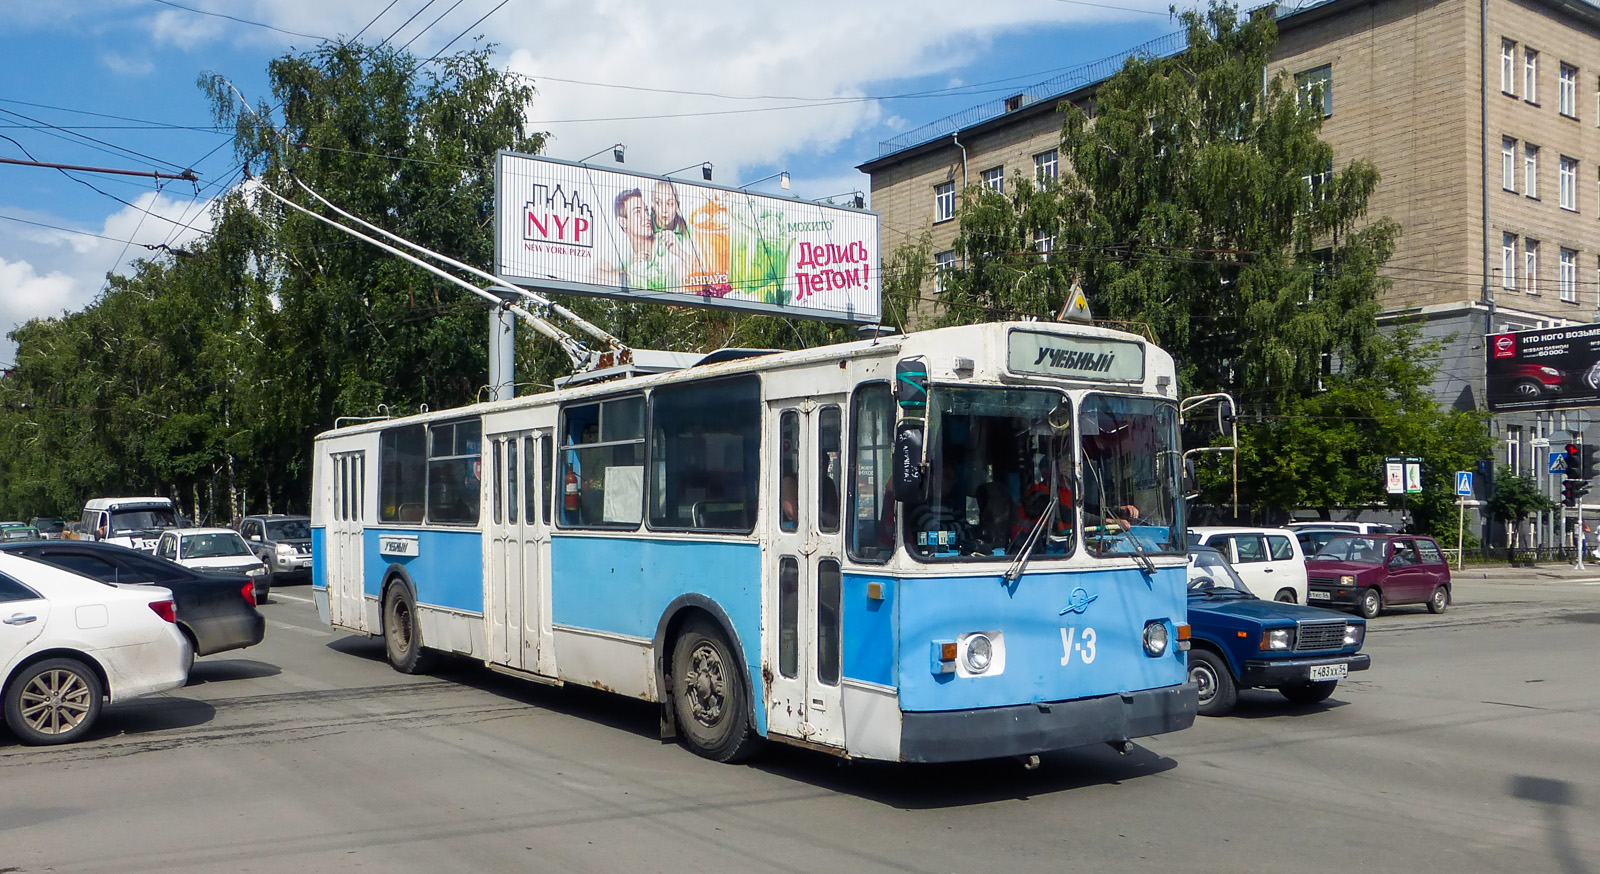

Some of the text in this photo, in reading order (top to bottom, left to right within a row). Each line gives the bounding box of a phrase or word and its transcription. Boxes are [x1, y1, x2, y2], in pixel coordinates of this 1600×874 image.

[528, 211, 589, 242] NYP
[524, 243, 592, 258] NEW YORK PIZZA
[1523, 335, 1540, 344] КТО
[1541, 332, 1564, 342] КОГО
[1033, 346, 1115, 373] УЧЕБНЫЙ
[1060, 626, 1097, 667] У-3
